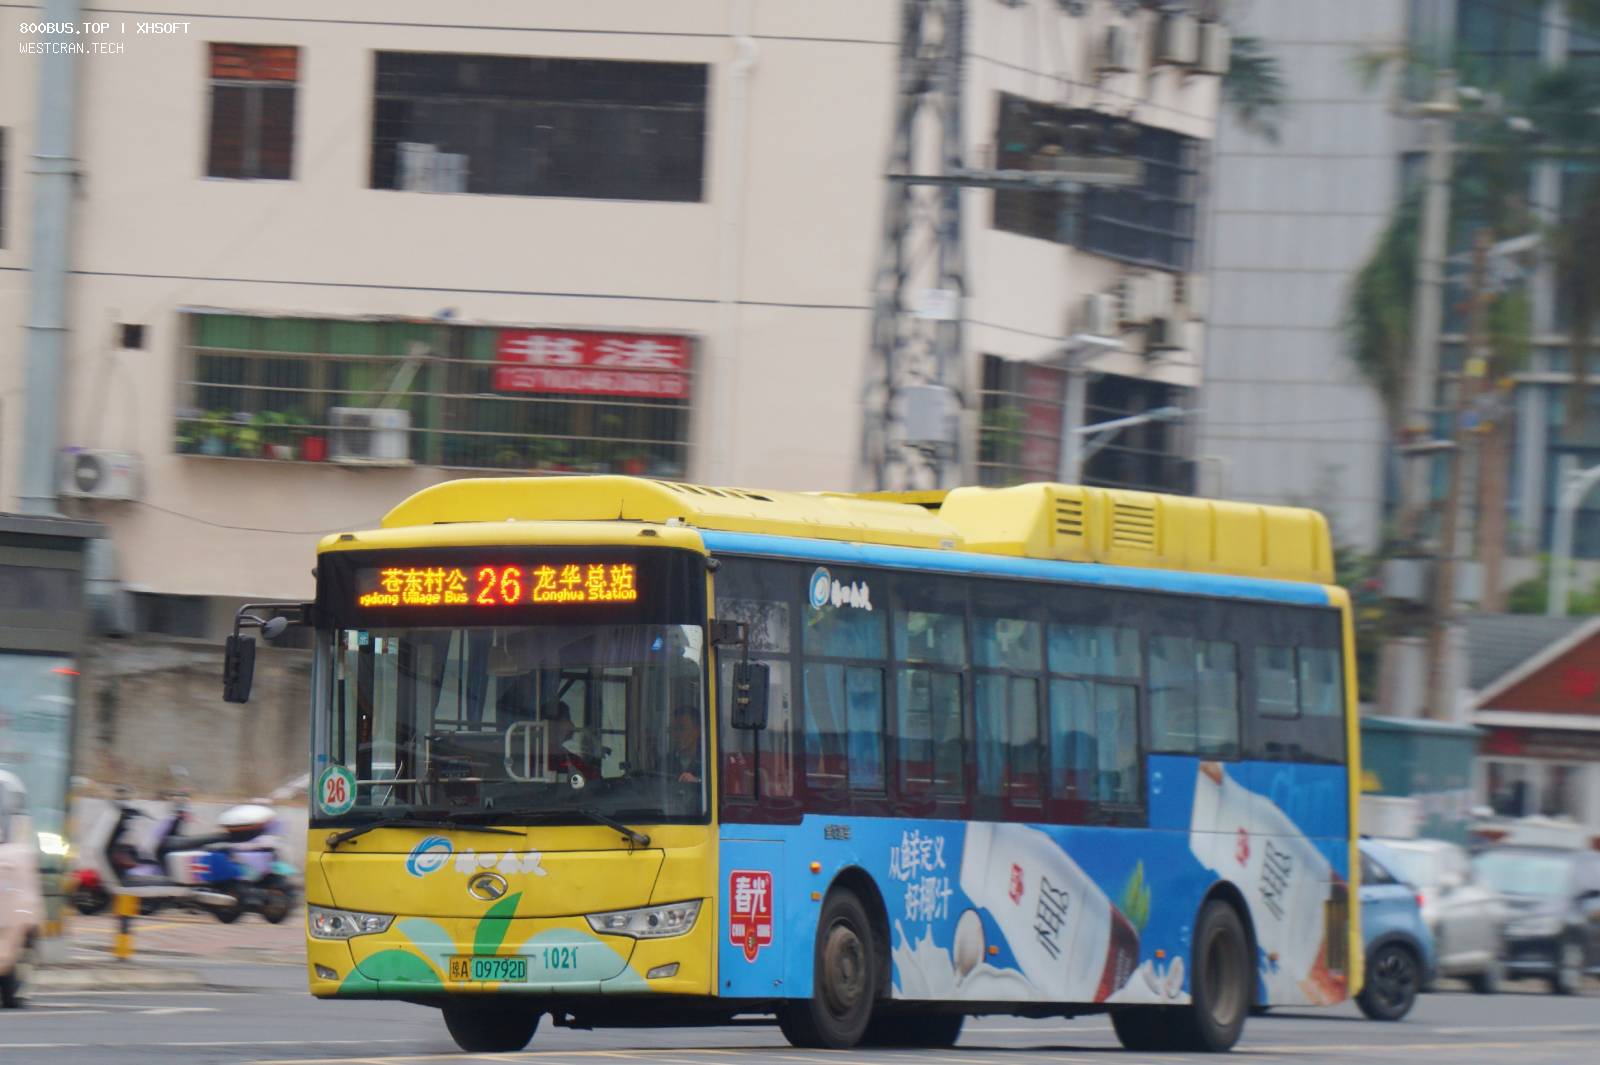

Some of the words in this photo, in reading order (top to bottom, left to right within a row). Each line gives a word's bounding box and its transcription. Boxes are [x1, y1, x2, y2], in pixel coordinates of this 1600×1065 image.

[380, 567, 468, 593] 苍东村公
[477, 567, 522, 605] 26
[533, 564, 634, 591] 龙华总站
[402, 591, 442, 605] Village
[444, 590, 469, 604] Bus
[533, 587, 584, 603] Longhua
[588, 587, 637, 601] Station
[327, 777, 346, 804] 26
[888, 828, 947, 882] 从鲜定义
[735, 876, 768, 922] 春光
[475, 960, 526, 978] 09792D
[543, 947, 578, 969] 1021
